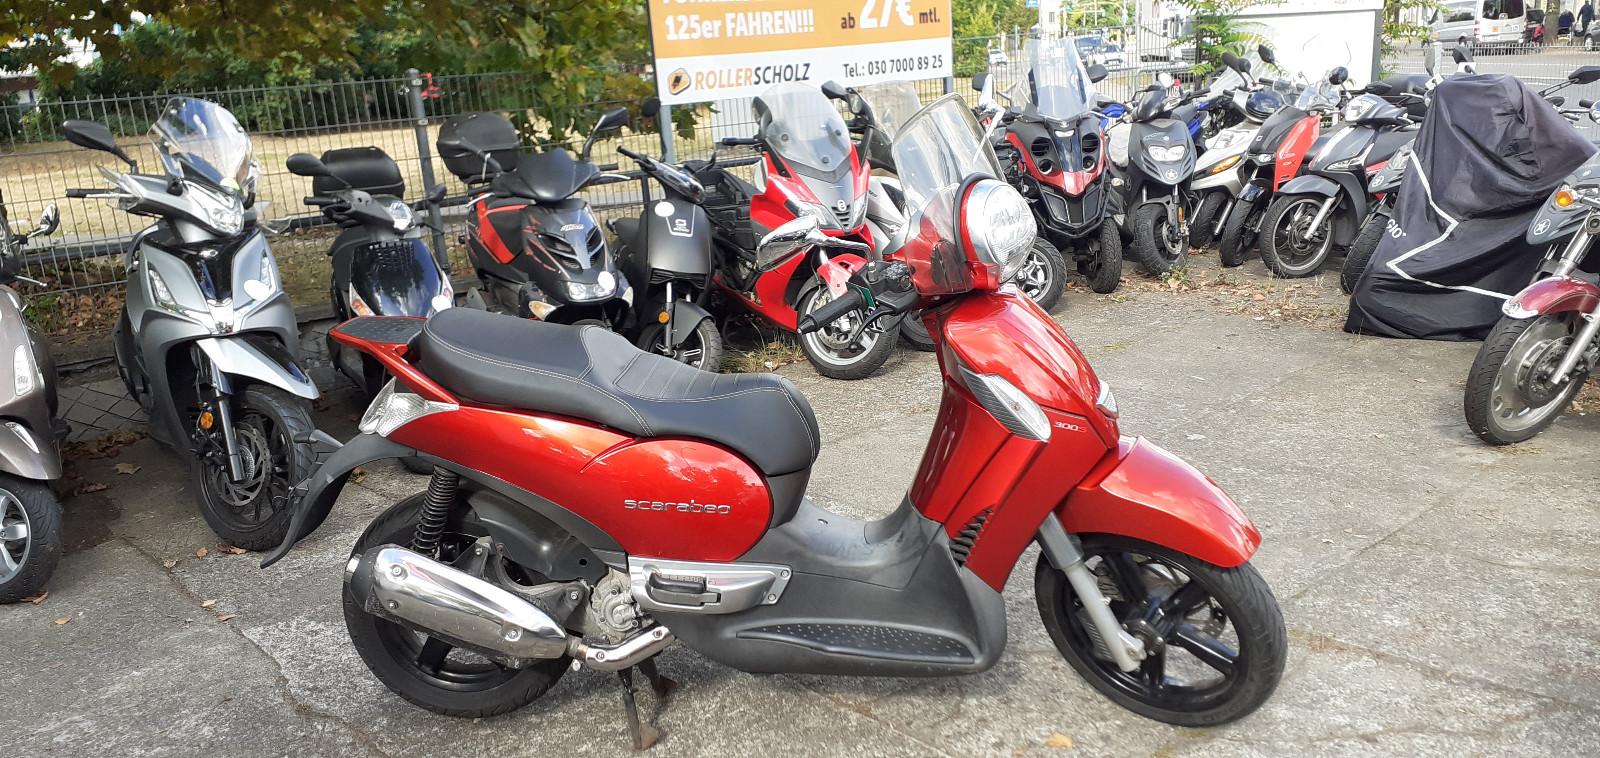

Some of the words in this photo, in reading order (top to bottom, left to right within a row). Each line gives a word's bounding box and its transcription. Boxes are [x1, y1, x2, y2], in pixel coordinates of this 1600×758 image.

[665, 14, 722, 41] 125er
[724, 9, 814, 37] FAHREN!!!
[841, 12, 856, 29] ab
[859, 0, 915, 29] 27€
[919, 7, 940, 24] mtl.
[695, 63, 811, 90] ROLLERSCHOLZ
[843, 62, 865, 78] Tel.:
[868, 60, 887, 75] 030
[889, 57, 915, 73] 7000
[917, 56, 929, 70] 89
[932, 54, 943, 69] 25
[624, 499, 731, 514] scarabeo
